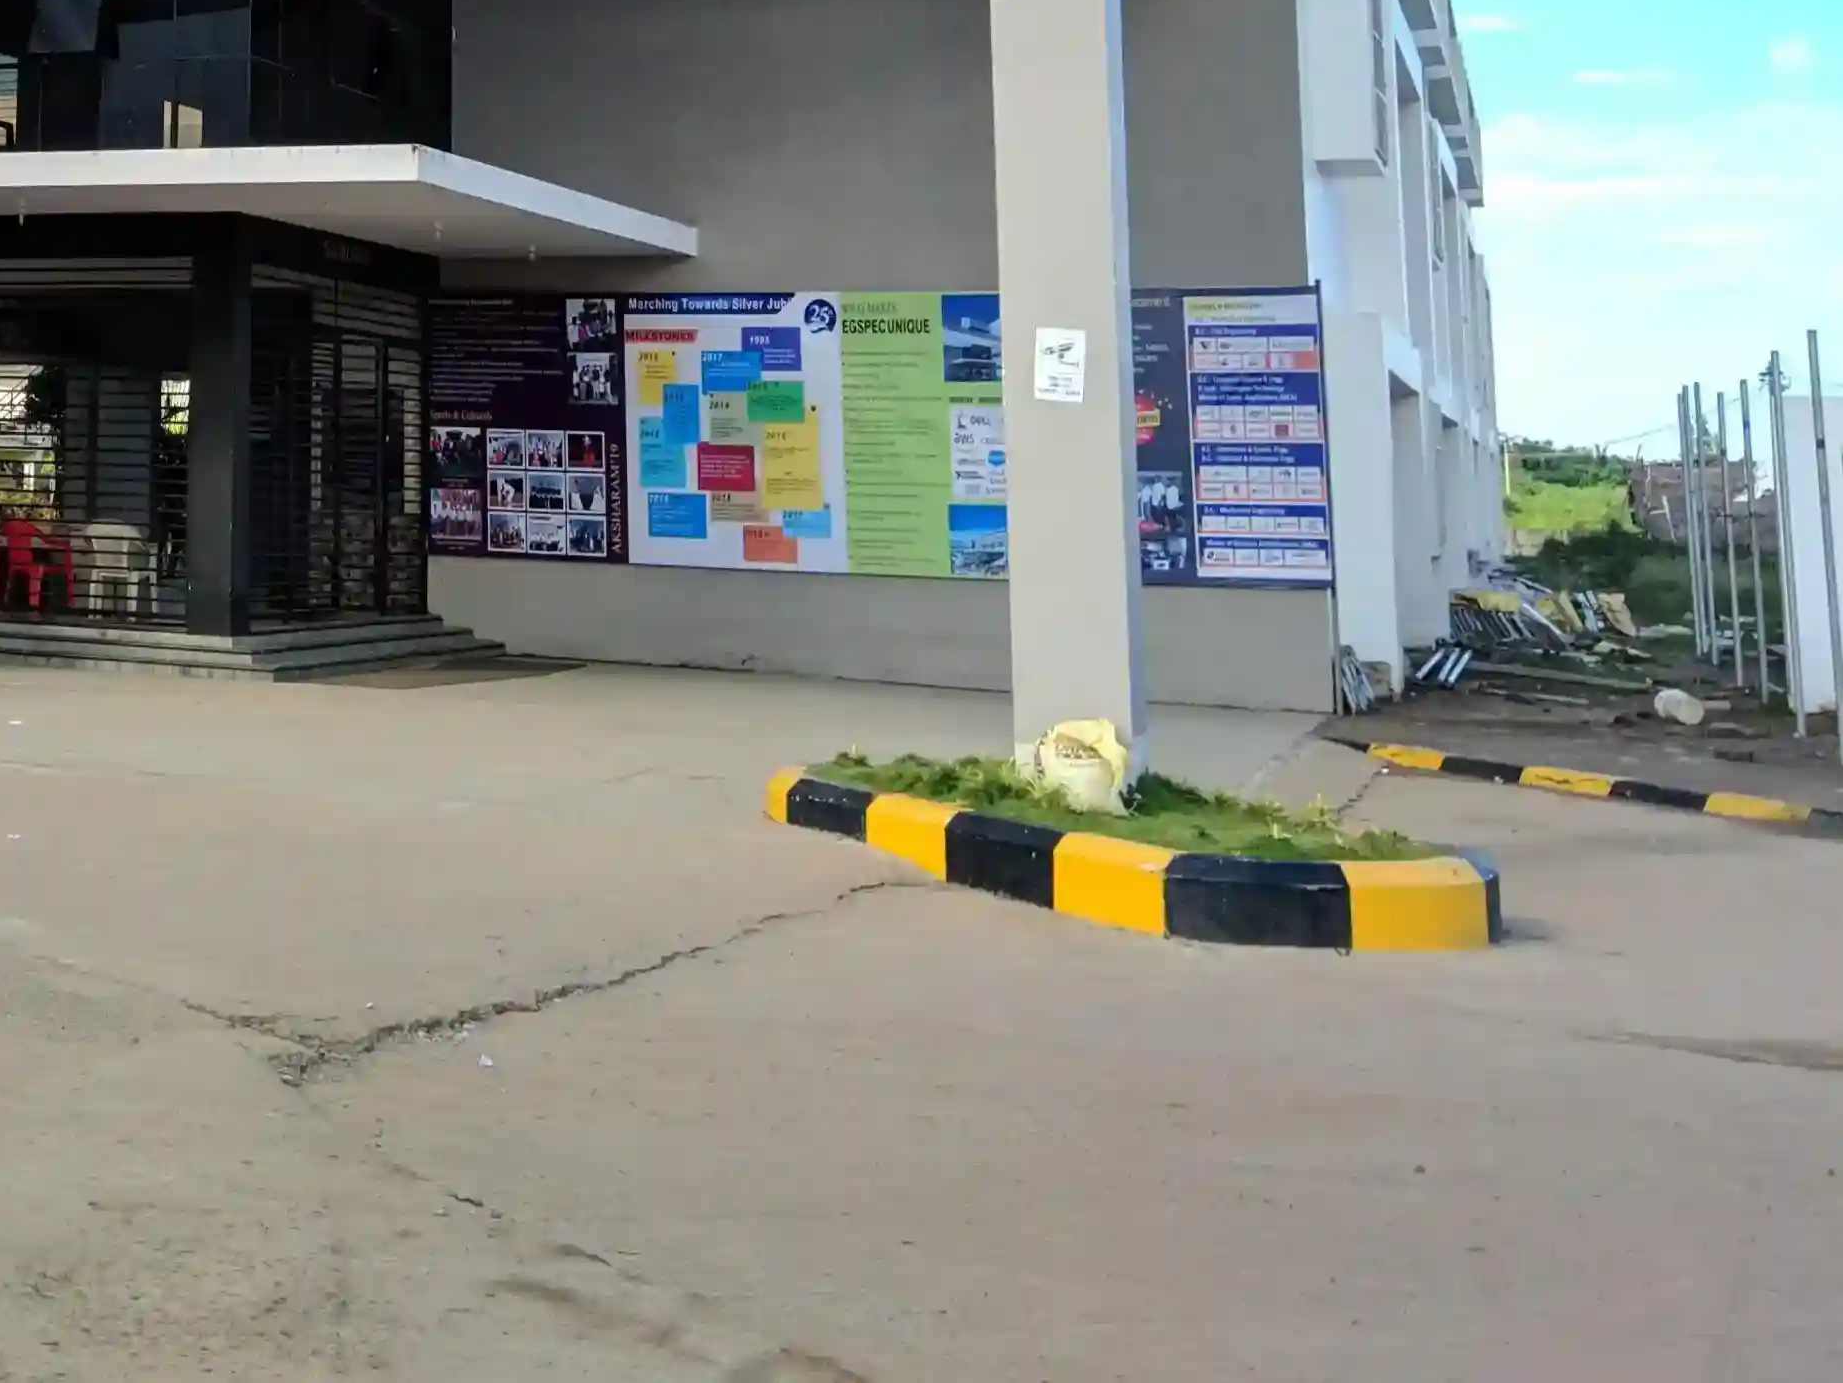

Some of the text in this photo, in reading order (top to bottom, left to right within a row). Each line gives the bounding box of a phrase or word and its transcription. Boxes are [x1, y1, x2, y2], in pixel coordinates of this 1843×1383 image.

[629, 298, 678, 312] Marching
[681, 298, 728, 311] Towards
[732, 297, 763, 310] Silver
